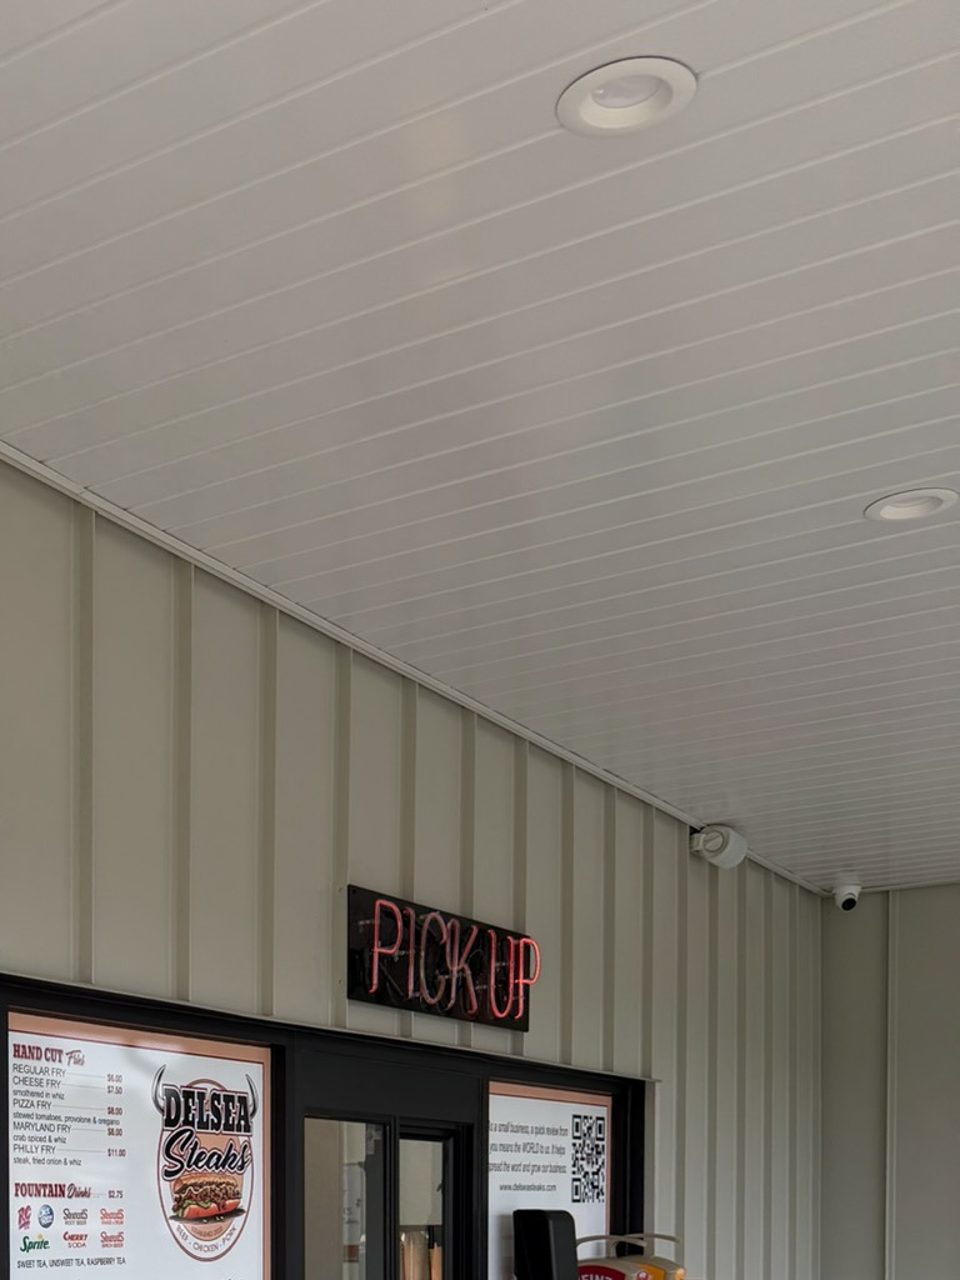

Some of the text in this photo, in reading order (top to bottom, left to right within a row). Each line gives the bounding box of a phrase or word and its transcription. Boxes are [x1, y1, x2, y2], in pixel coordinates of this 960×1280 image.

[368, 899, 541, 1019] PICK UP
[13, 1043, 42, 1060] HAND
[44, 1047, 63, 1063] CUT
[12, 1063, 50, 1076] REGULAR
[51, 1067, 66, 1077] FRY
[12, 1076, 44, 1088] CHEESE
[46, 1079, 61, 1089] FRY
[12, 1089, 64, 1100] smothered in whiz
[13, 1098, 36, 1109] PIZZA
[37, 1100, 52, 1110] FRY
[162, 1084, 253, 1134] DELSEA
[13, 1121, 55, 1133] MARYLAND
[57, 1124, 72, 1133] FRY
[13, 1143, 39, 1154] PHILLY
[41, 1145, 56, 1154] FRY
[162, 1127, 252, 1180] Steaks
[14, 1183, 66, 1198] FOUNTAIN
[20, 1235, 50, 1253] Sprite
[17, 1260, 35, 1269] SWEET
[87, 1257, 115, 1266] RASPBERRY
[116, 1256, 126, 1265] TEA
